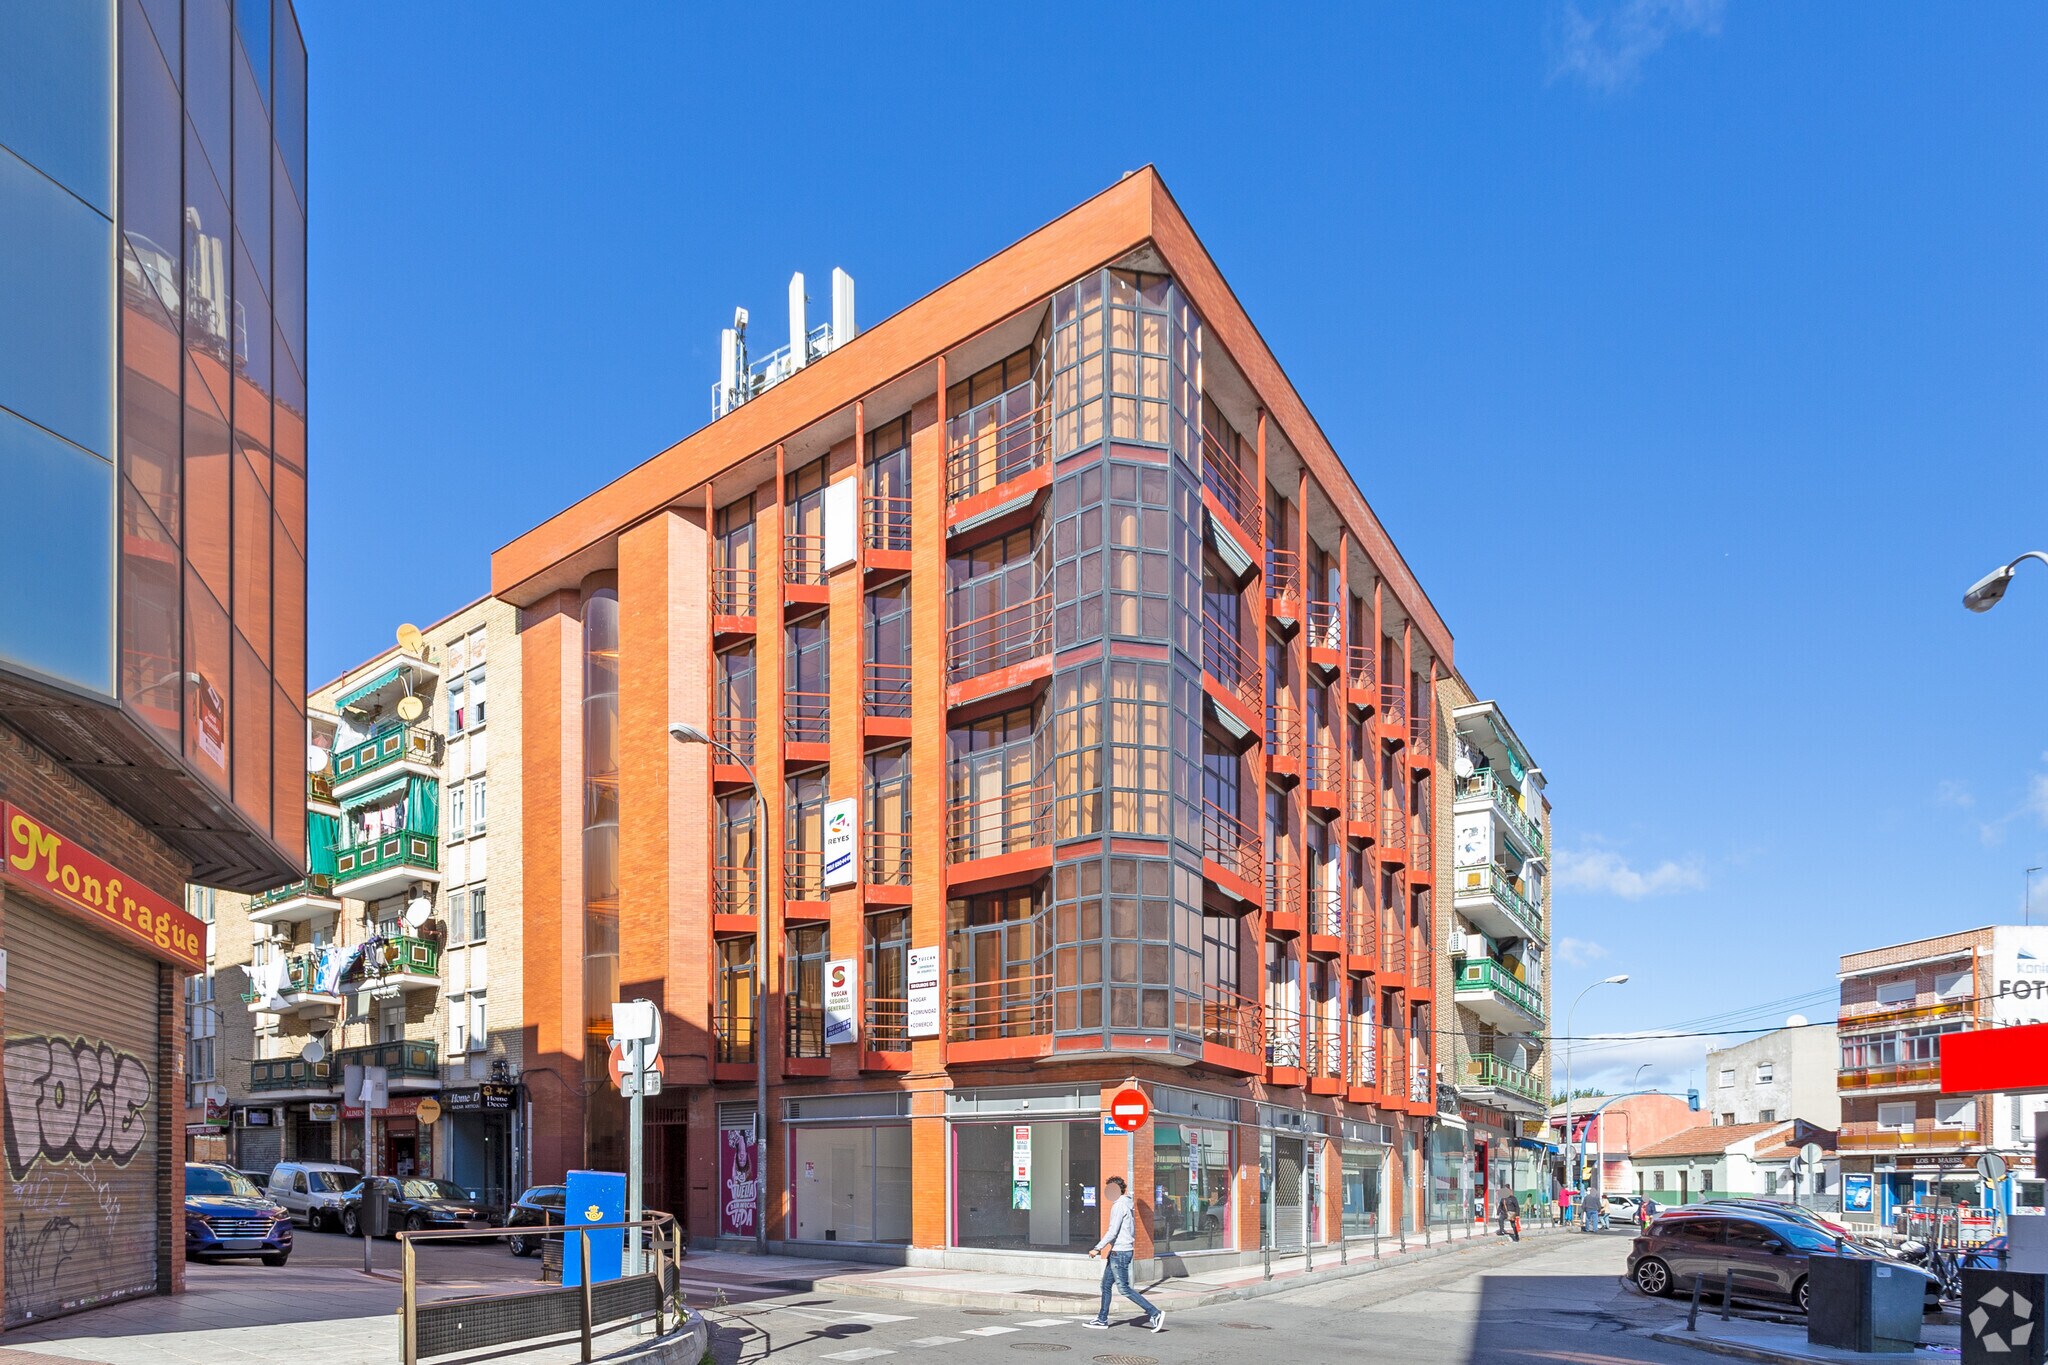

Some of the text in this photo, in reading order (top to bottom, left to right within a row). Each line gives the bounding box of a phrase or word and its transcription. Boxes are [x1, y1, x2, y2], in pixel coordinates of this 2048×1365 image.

[828, 835, 850, 844] REYES
[10, 815, 199, 955] Monfragüe
[2000, 980, 2048, 999] FOT
[451, 1093, 470, 1103] Home
